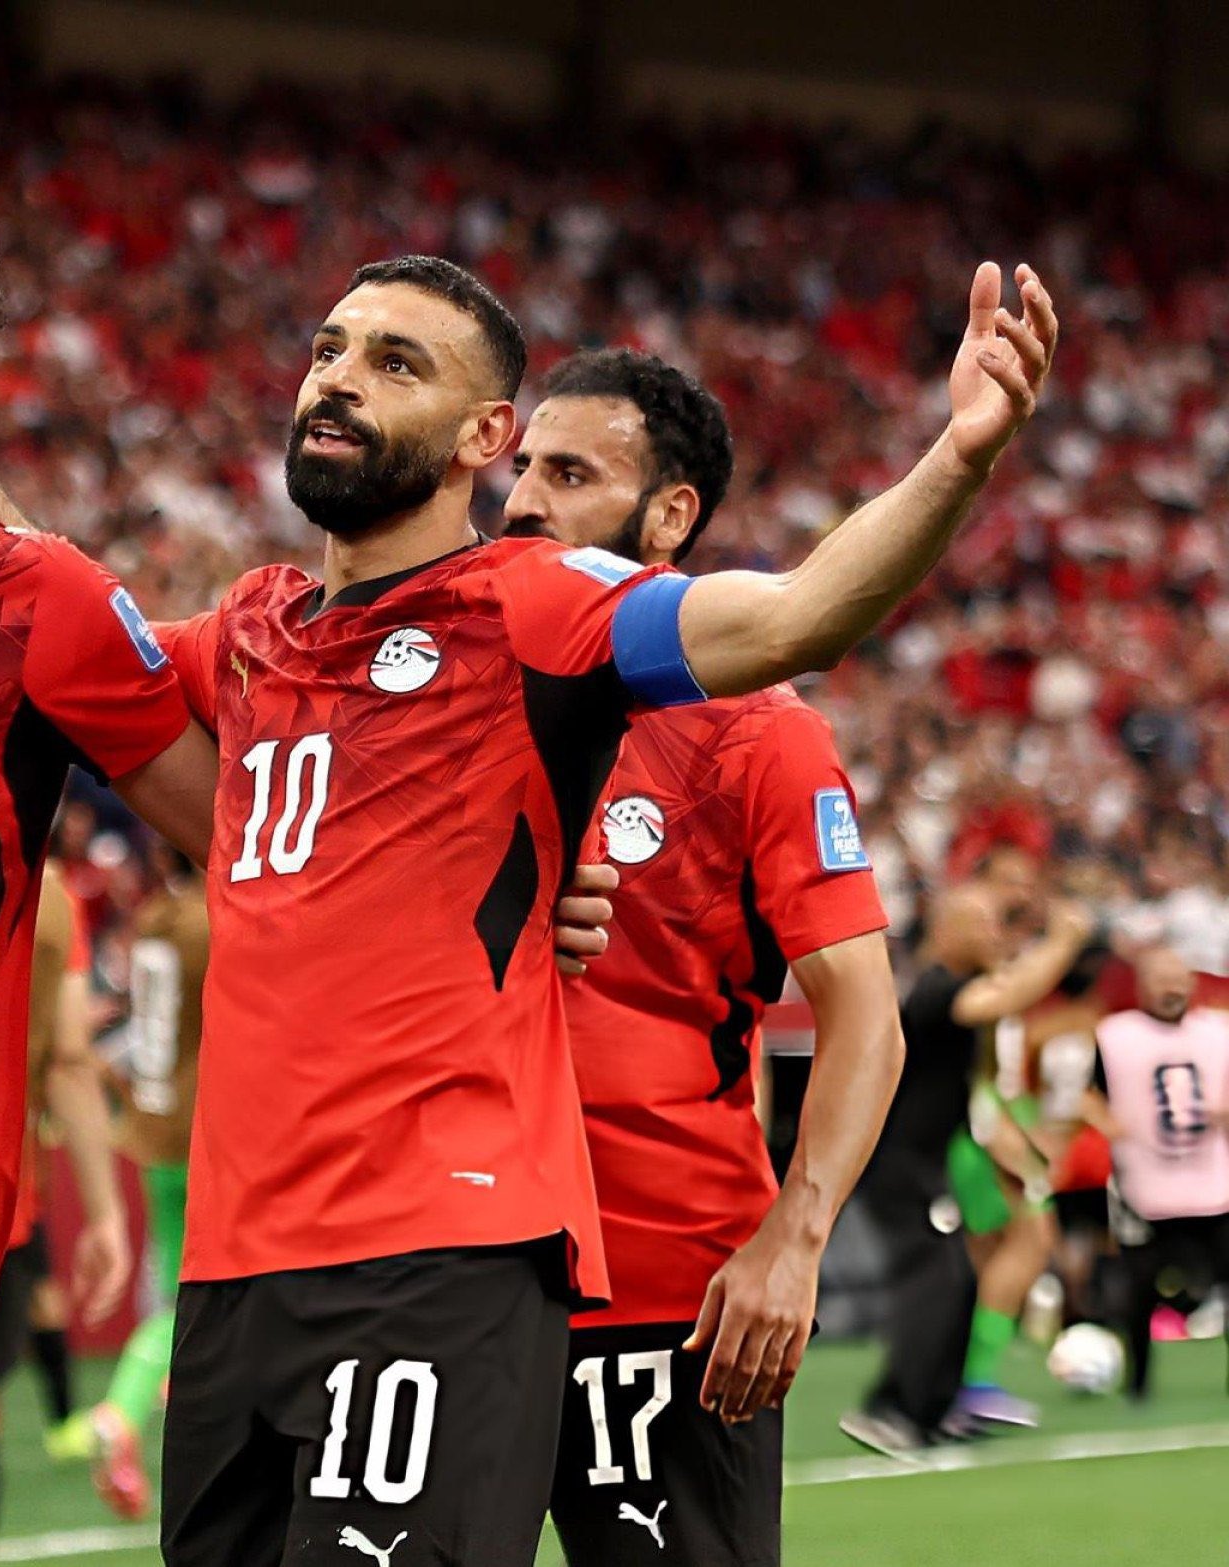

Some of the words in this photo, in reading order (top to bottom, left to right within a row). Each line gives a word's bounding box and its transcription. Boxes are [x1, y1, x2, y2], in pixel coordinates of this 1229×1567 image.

[230, 732, 334, 884] 10
[309, 1358, 439, 1505] 10
[572, 1349, 673, 1486] 17
